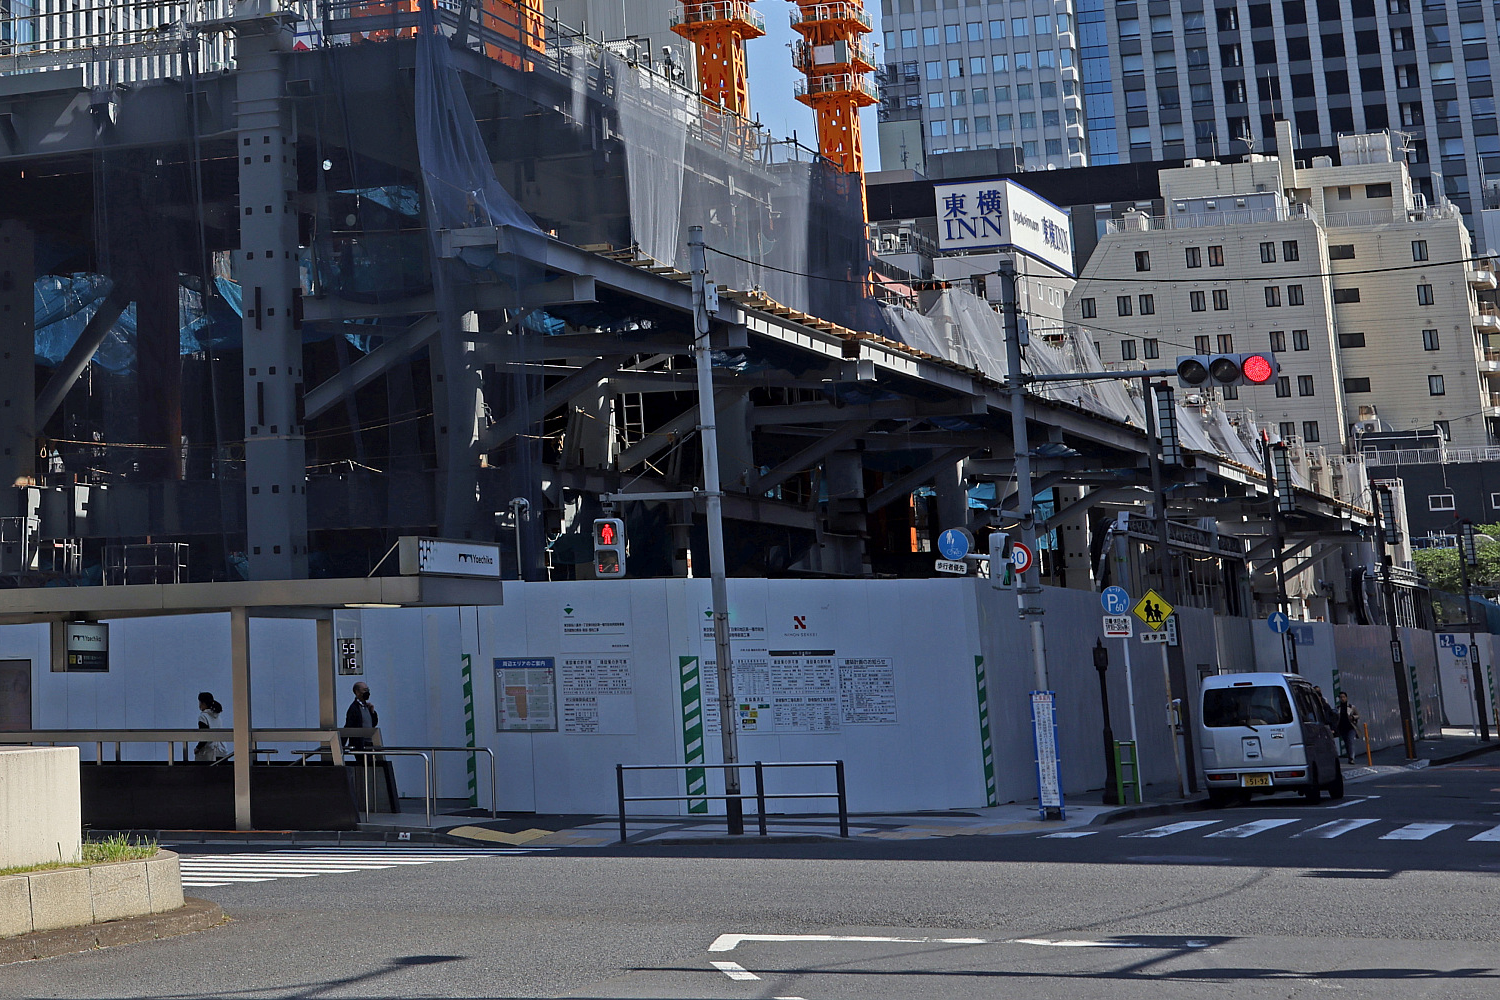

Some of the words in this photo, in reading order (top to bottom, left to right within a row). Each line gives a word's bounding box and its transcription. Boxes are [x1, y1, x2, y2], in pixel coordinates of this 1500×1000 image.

[942, 190, 1002, 218] 東横
[944, 215, 1002, 240] INN
[1011, 551, 1025, 564] 30
[938, 562, 965, 572] 歩行者優先
[1107, 594, 1118, 612] P
[342, 644, 356, 654] 59
[347, 658, 356, 668] 19
